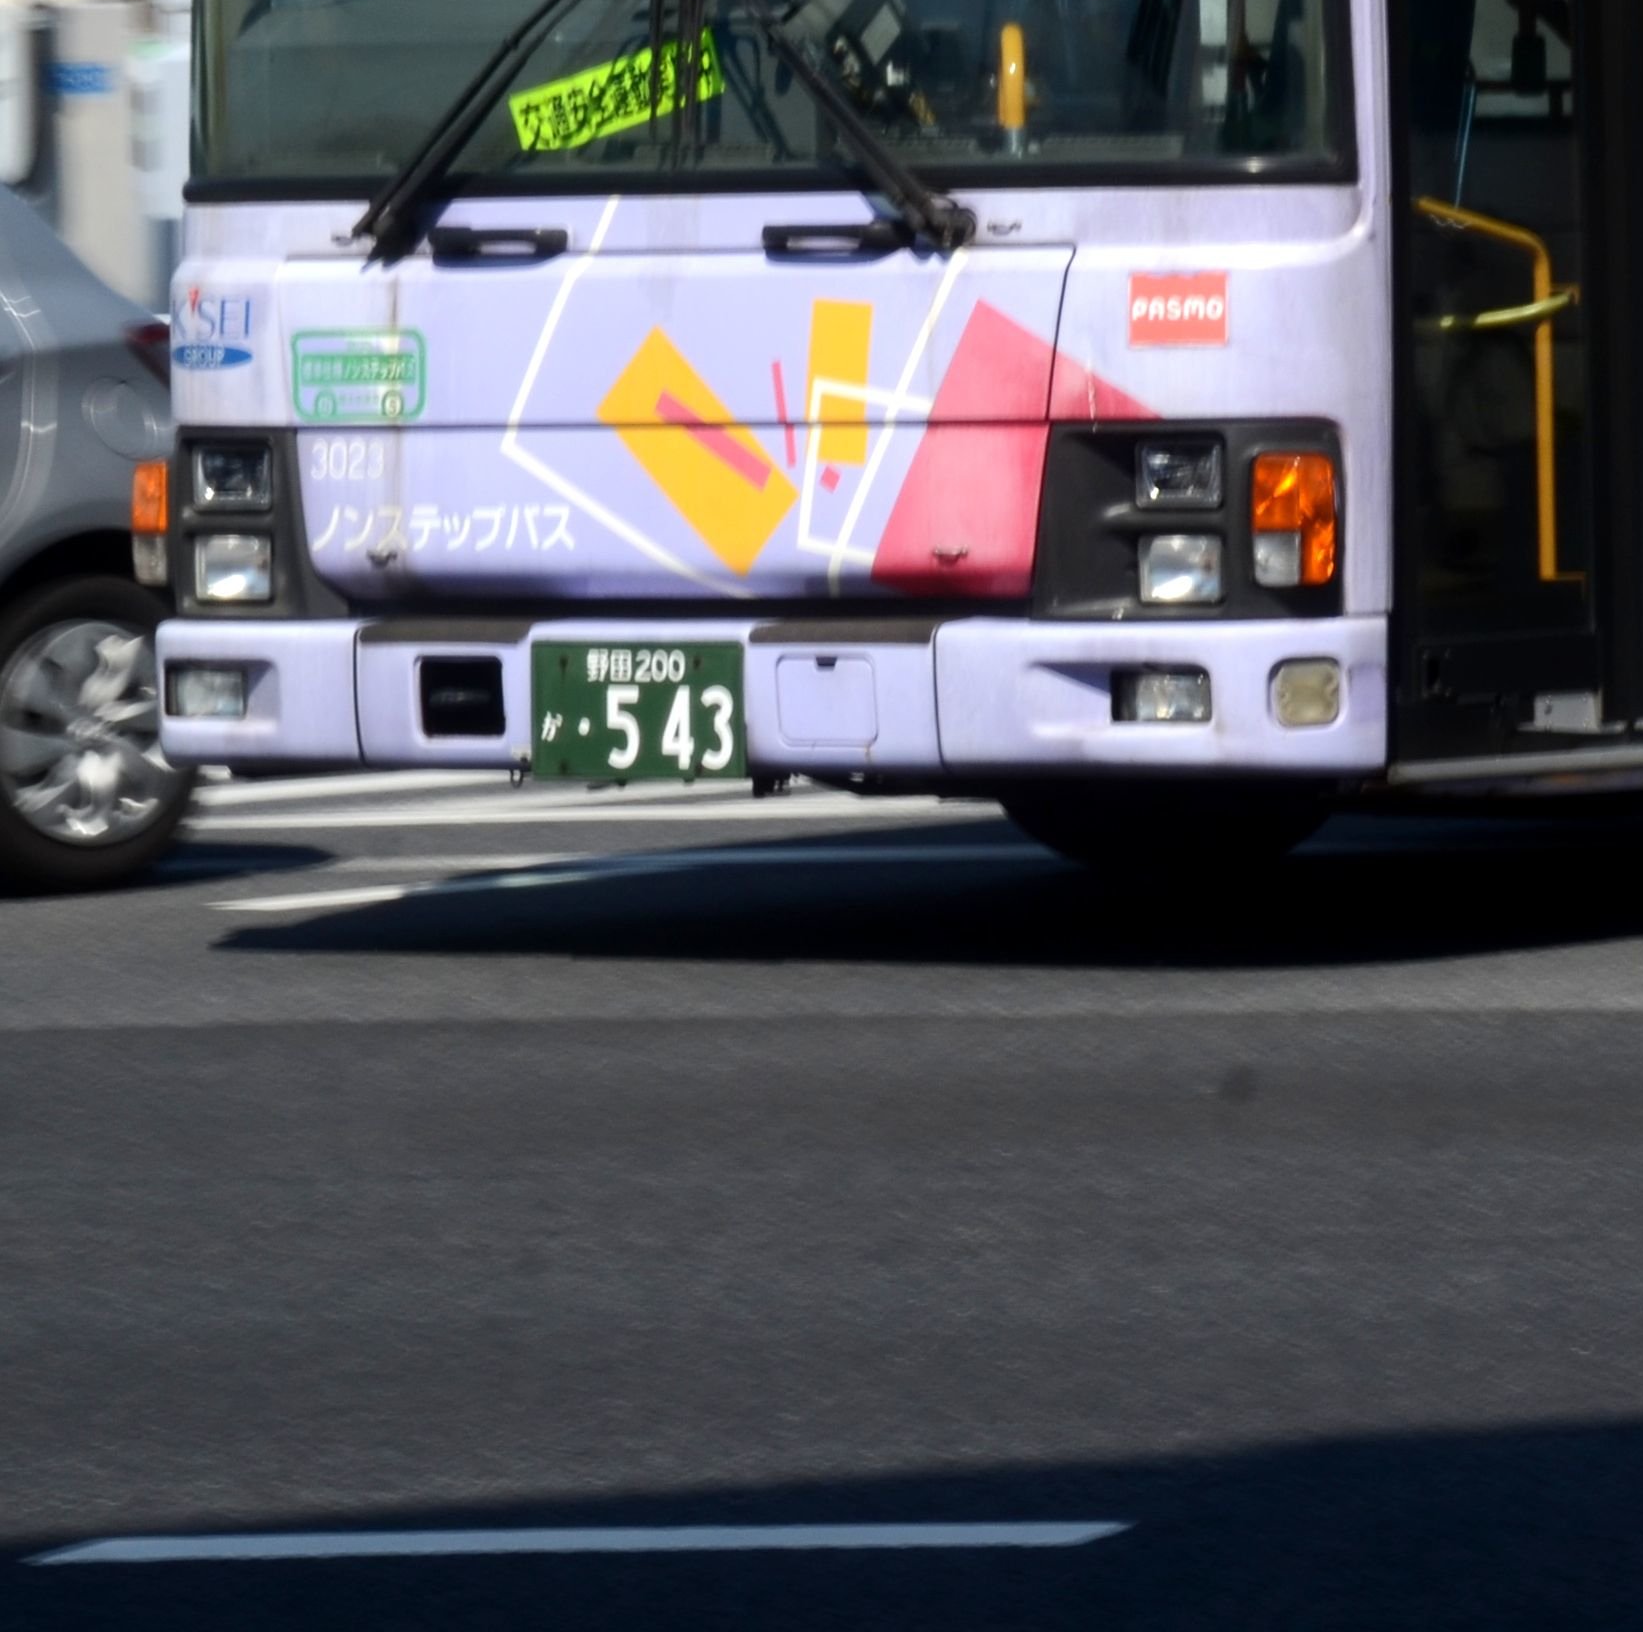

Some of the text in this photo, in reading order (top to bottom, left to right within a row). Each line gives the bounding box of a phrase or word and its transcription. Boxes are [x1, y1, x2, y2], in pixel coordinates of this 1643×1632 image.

[1132, 294, 1224, 321] PASMO
[311, 436, 385, 481] 3023
[312, 502, 575, 552] ノンステップバス
